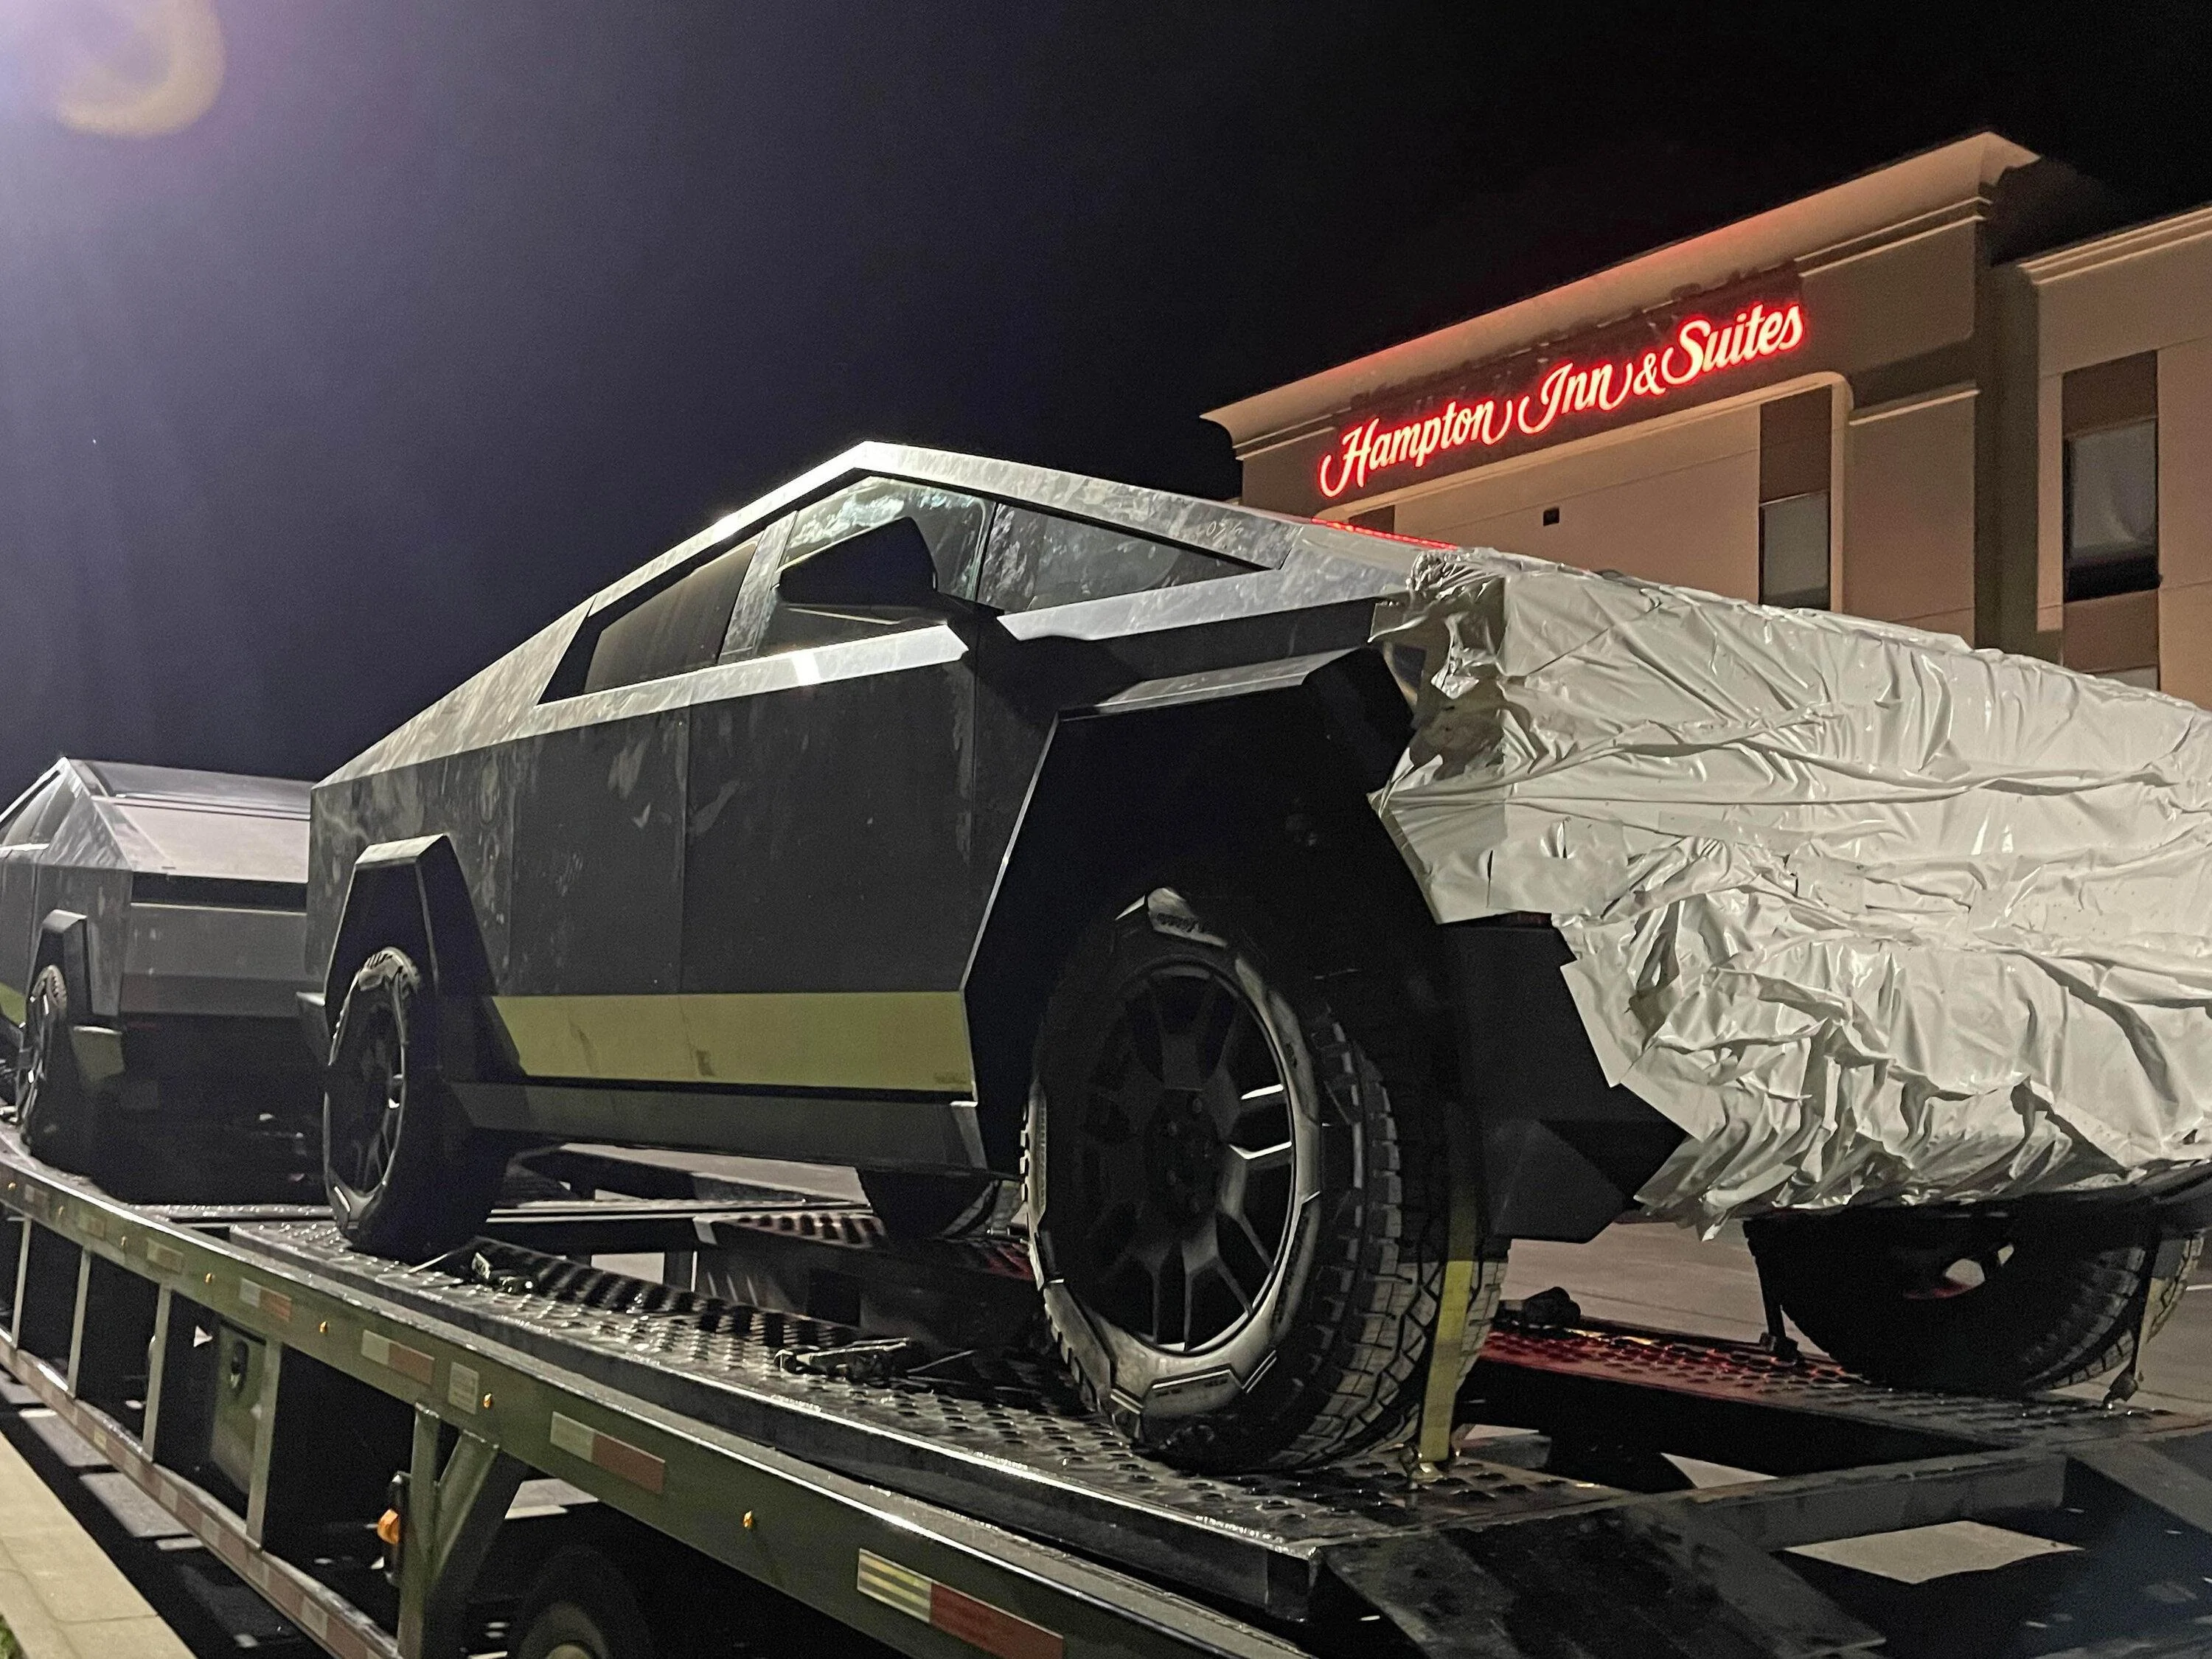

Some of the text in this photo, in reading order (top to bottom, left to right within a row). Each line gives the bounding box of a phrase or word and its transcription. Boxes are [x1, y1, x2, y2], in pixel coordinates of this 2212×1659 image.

[1320, 303, 1804, 498] Hampton Inn & Suites
